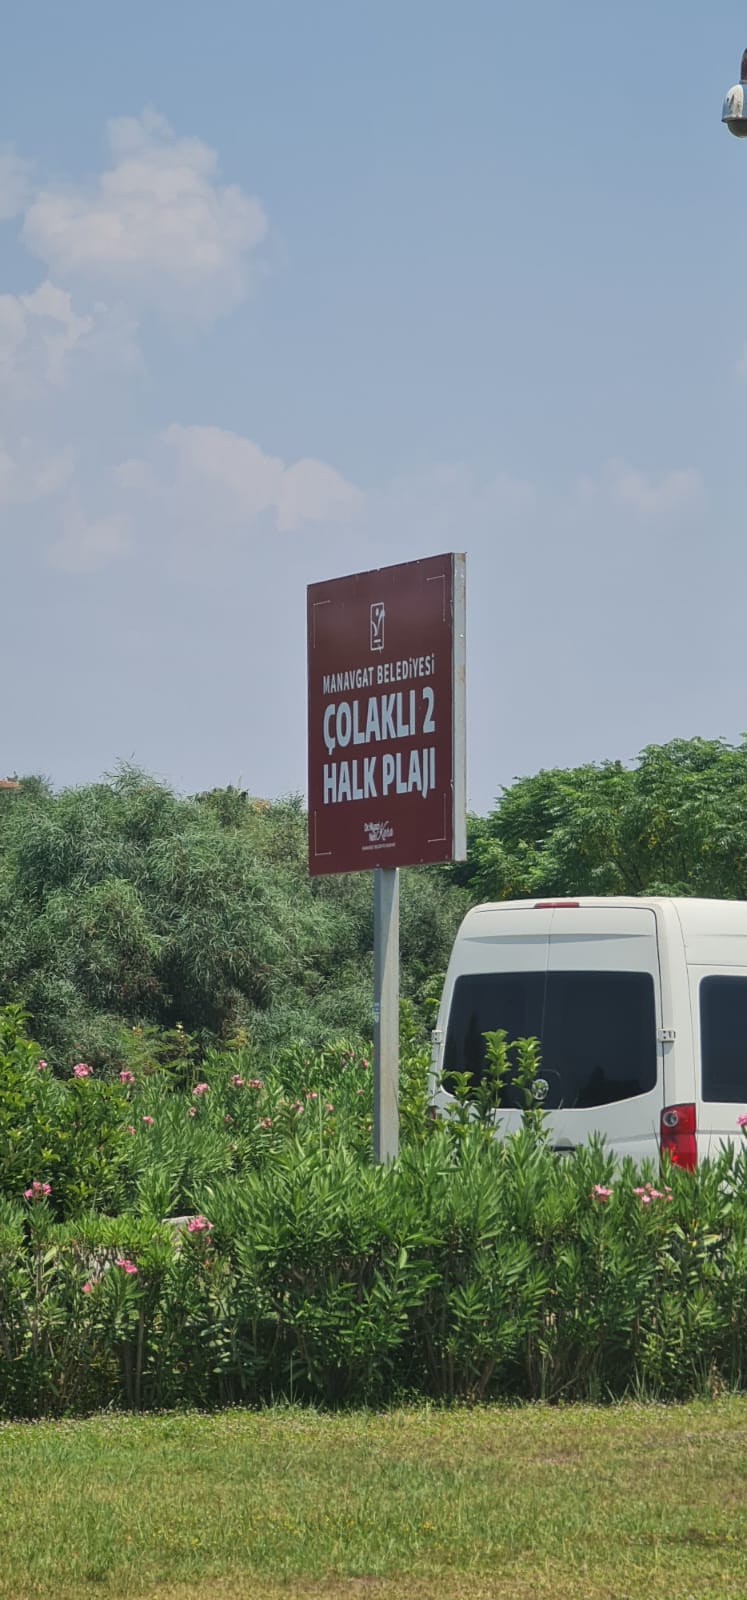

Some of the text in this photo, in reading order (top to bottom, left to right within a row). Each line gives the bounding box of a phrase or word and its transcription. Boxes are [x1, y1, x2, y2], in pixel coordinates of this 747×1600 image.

[323, 667, 374, 694] MANAVGAT
[323, 687, 435, 755] ÇOLAKLI 2
[323, 747, 435, 804] HALK PLAJI
